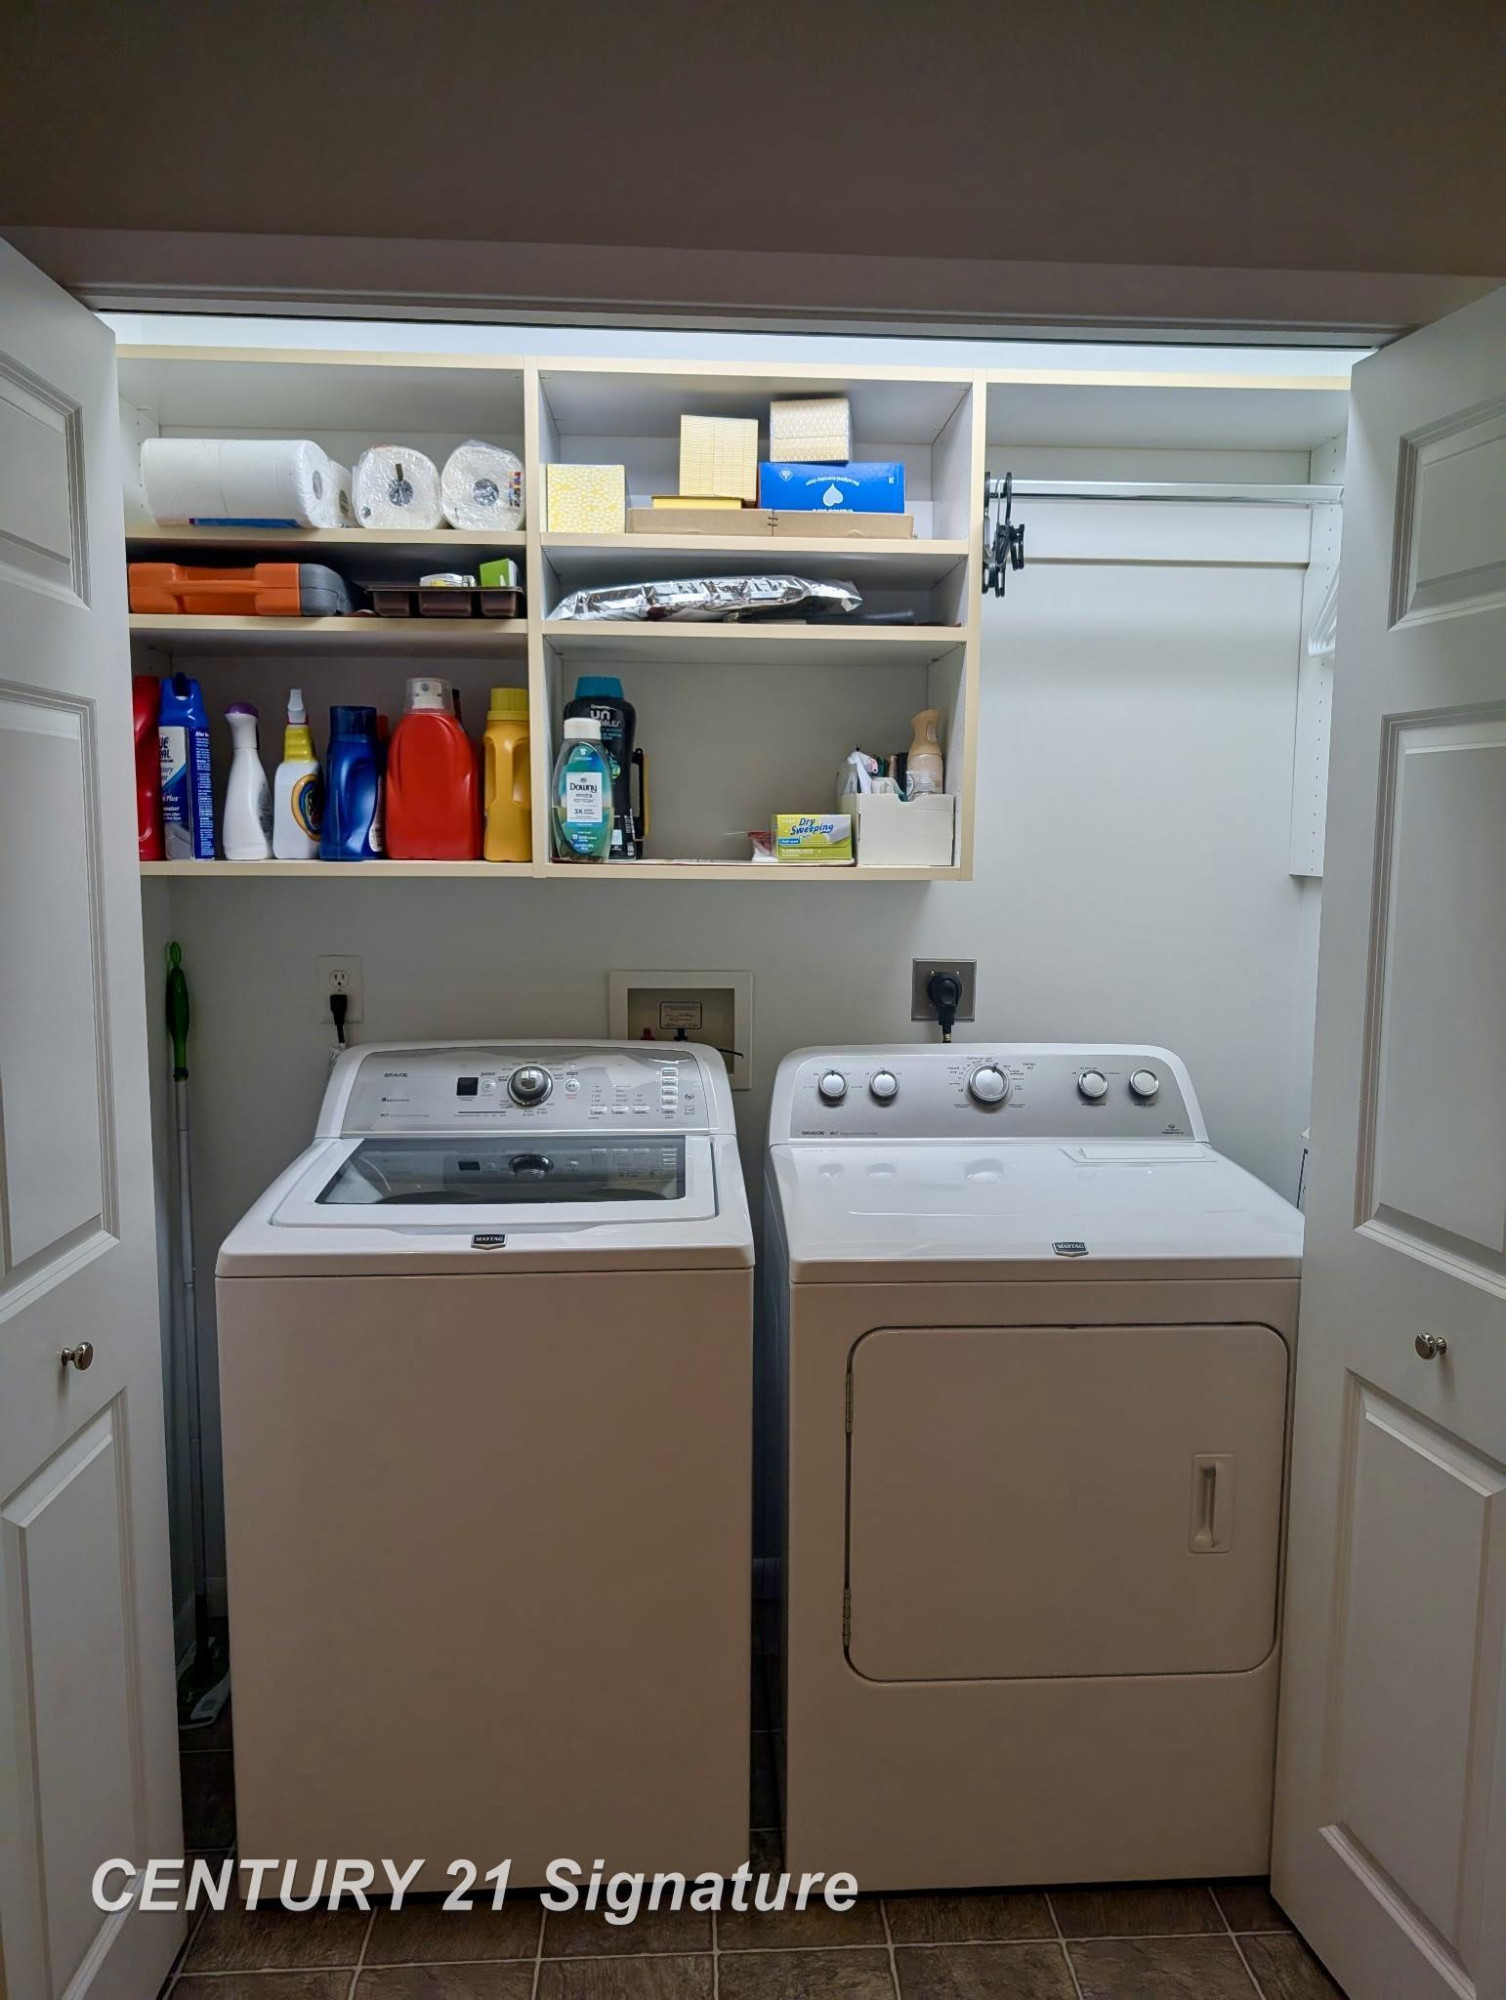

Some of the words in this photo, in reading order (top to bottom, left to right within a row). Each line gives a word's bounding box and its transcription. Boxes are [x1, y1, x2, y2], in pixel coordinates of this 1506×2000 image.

[569, 782, 598, 794] Downy
[799, 818, 815, 827] Dry
[790, 824, 834, 835] Sweeping
